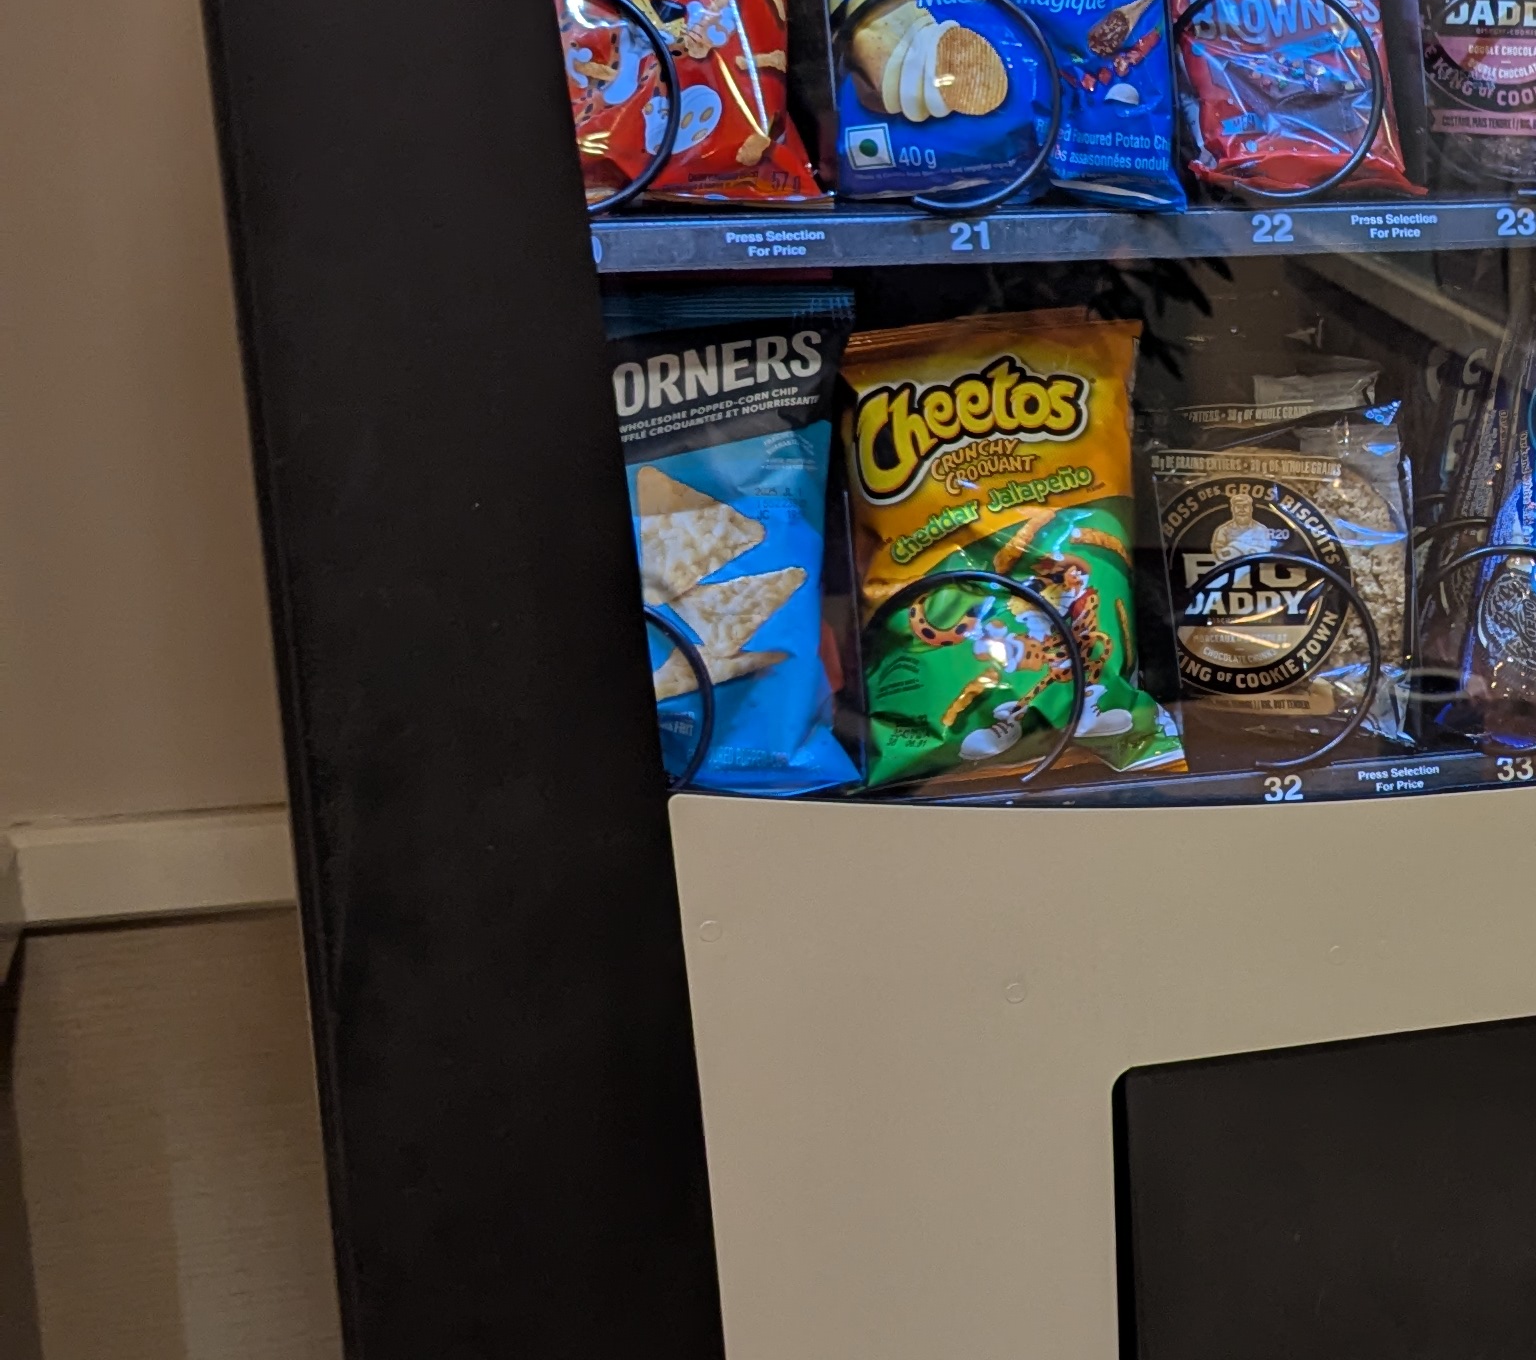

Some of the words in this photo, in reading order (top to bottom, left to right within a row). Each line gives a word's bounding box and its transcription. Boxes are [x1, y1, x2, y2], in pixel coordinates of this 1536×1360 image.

[1115, 131, 1150, 149] Potato
[899, 146, 922, 167] 40
[1252, 214, 1294, 243] 22
[1351, 214, 1383, 226] Press
[1385, 212, 1438, 225] Selection
[1496, 207, 1536, 237] 23
[726, 231, 763, 243] Press
[765, 229, 825, 242] Selection
[949, 221, 991, 251] 21
[1370, 227, 1390, 239] For
[1391, 226, 1421, 239] Price
[748, 245, 770, 258] For
[772, 244, 807, 257] Price
[771, 386, 799, 398] CHIP
[861, 361, 1078, 493] Cheetos
[931, 438, 1019, 481] CRUNCHY
[1206, 457, 1242, 471] ENTIERS
[945, 455, 1035, 495] CROQUANT
[1225, 483, 1277, 502] GROS
[891, 499, 979, 563] Cheddar
[986, 466, 1094, 512] Jalapeño
[1183, 553, 1308, 589] BIG
[1185, 590, 1307, 615] DADDY
[1235, 658, 1300, 689] COOKIE
[1296, 610, 1339, 664] TOWN
[1357, 769, 1388, 781] Press
[1390, 764, 1440, 778] Selection
[1496, 756, 1534, 782] 33
[1264, 774, 1304, 802] 32
[1375, 781, 1395, 792] For
[1396, 779, 1424, 791] Price
